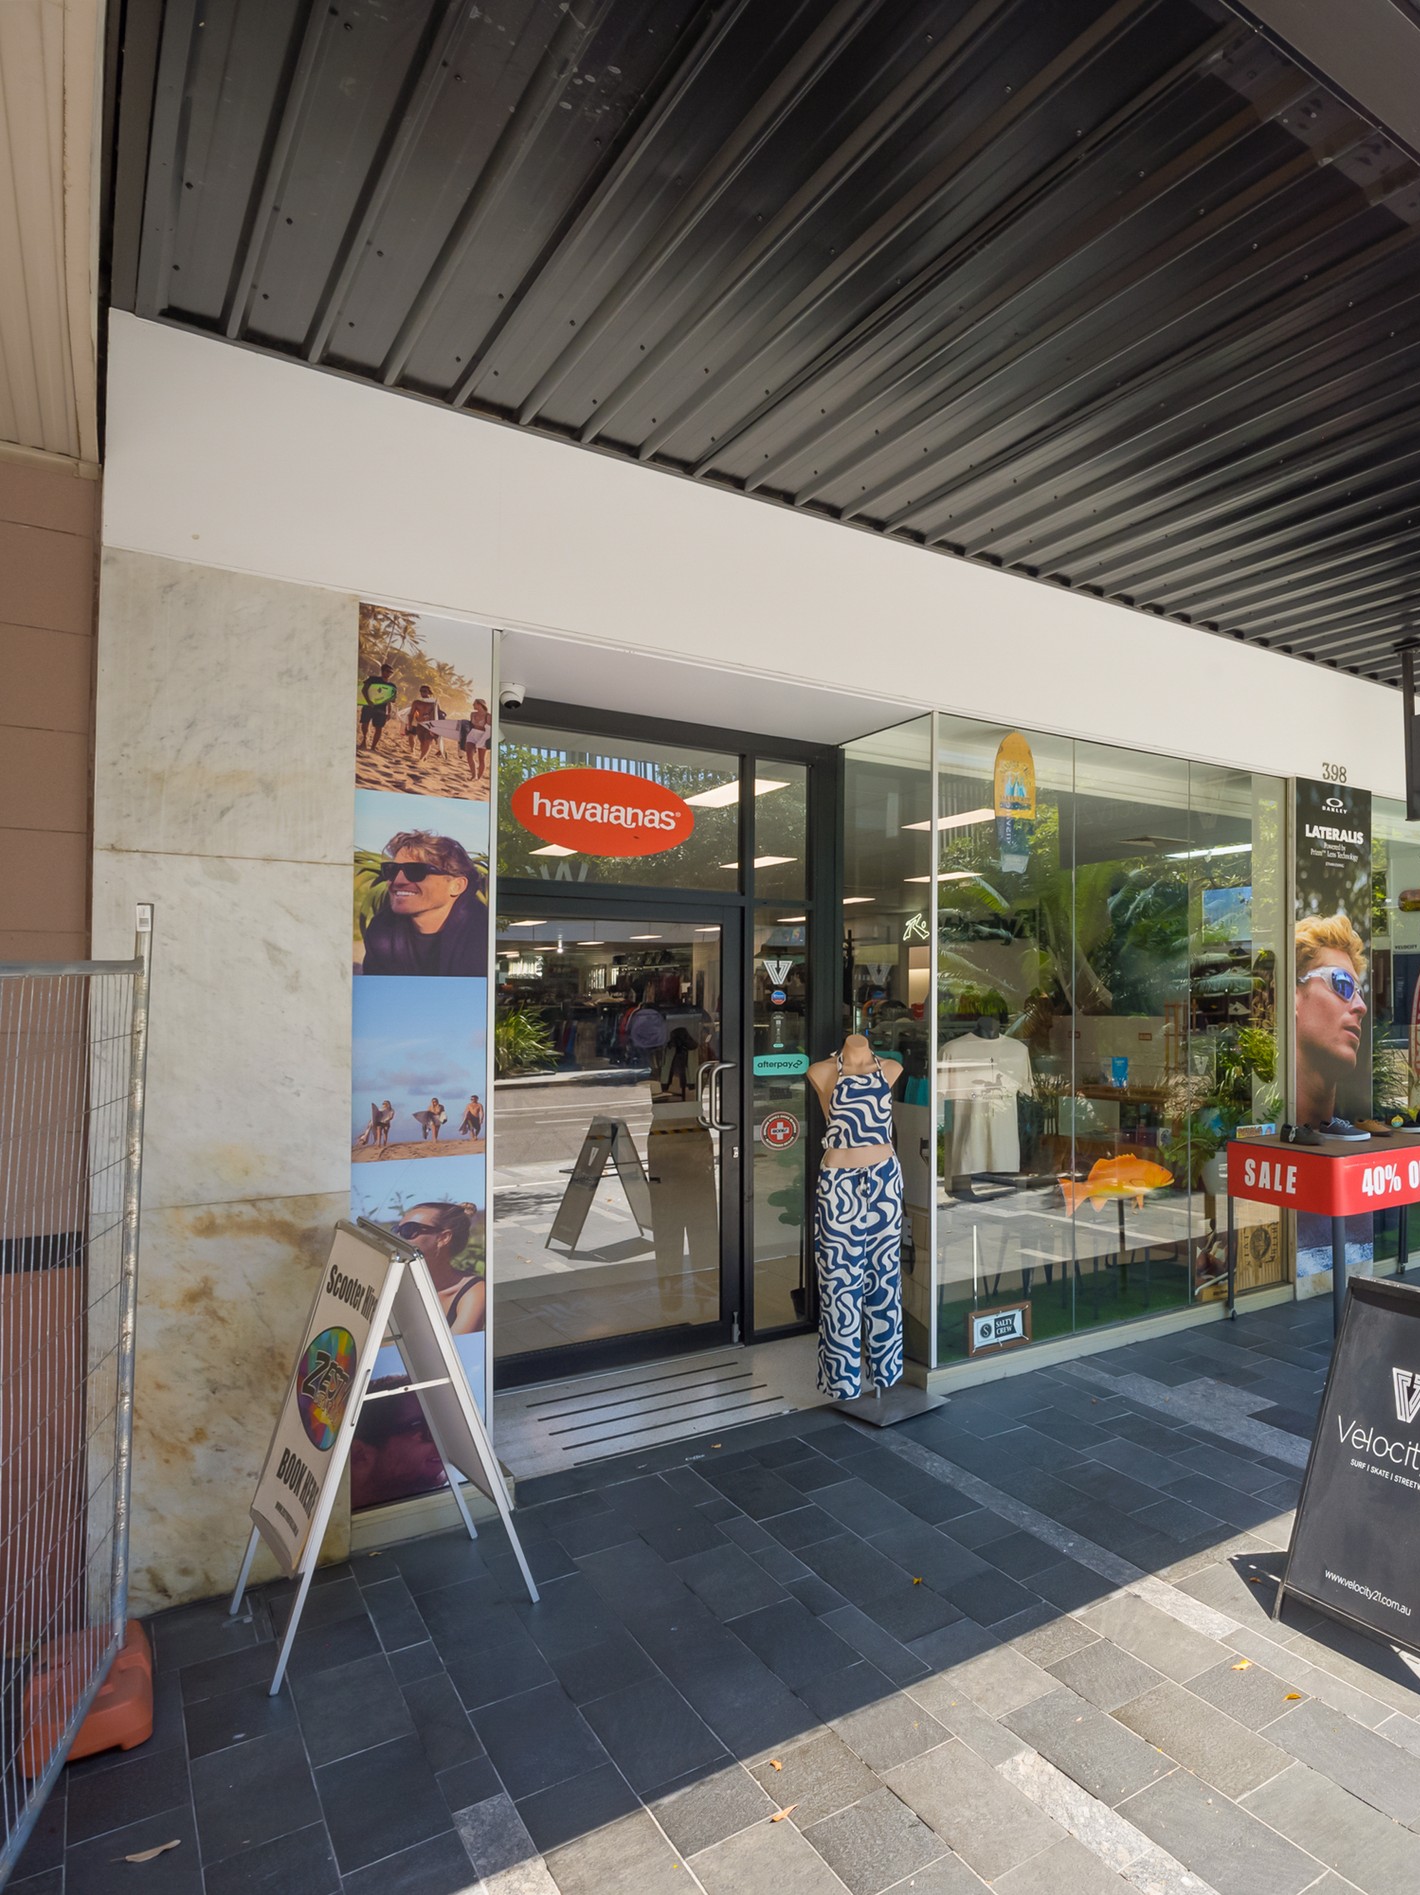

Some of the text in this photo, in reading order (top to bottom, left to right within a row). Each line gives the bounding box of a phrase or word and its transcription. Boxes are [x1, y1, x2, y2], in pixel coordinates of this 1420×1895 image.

[1322, 762, 1347, 783] 398
[1322, 805, 1348, 814] OAKLEY
[1305, 824, 1364, 845] LATERALIS
[757, 1061, 794, 1070] afterpay
[1244, 1158, 1297, 1194] SALE
[1362, 1163, 1402, 1197] 40%
[326, 1264, 365, 1311] Scooter
[996, 1318, 1012, 1327] SALTY
[996, 1326, 1012, 1335] CREW
[276, 1447, 308, 1498] BOOK
[1350, 1458, 1367, 1473] SURF
[1370, 1465, 1390, 1479] SKATE
[1324, 1568, 1412, 1617] www.velocity21.com.au
